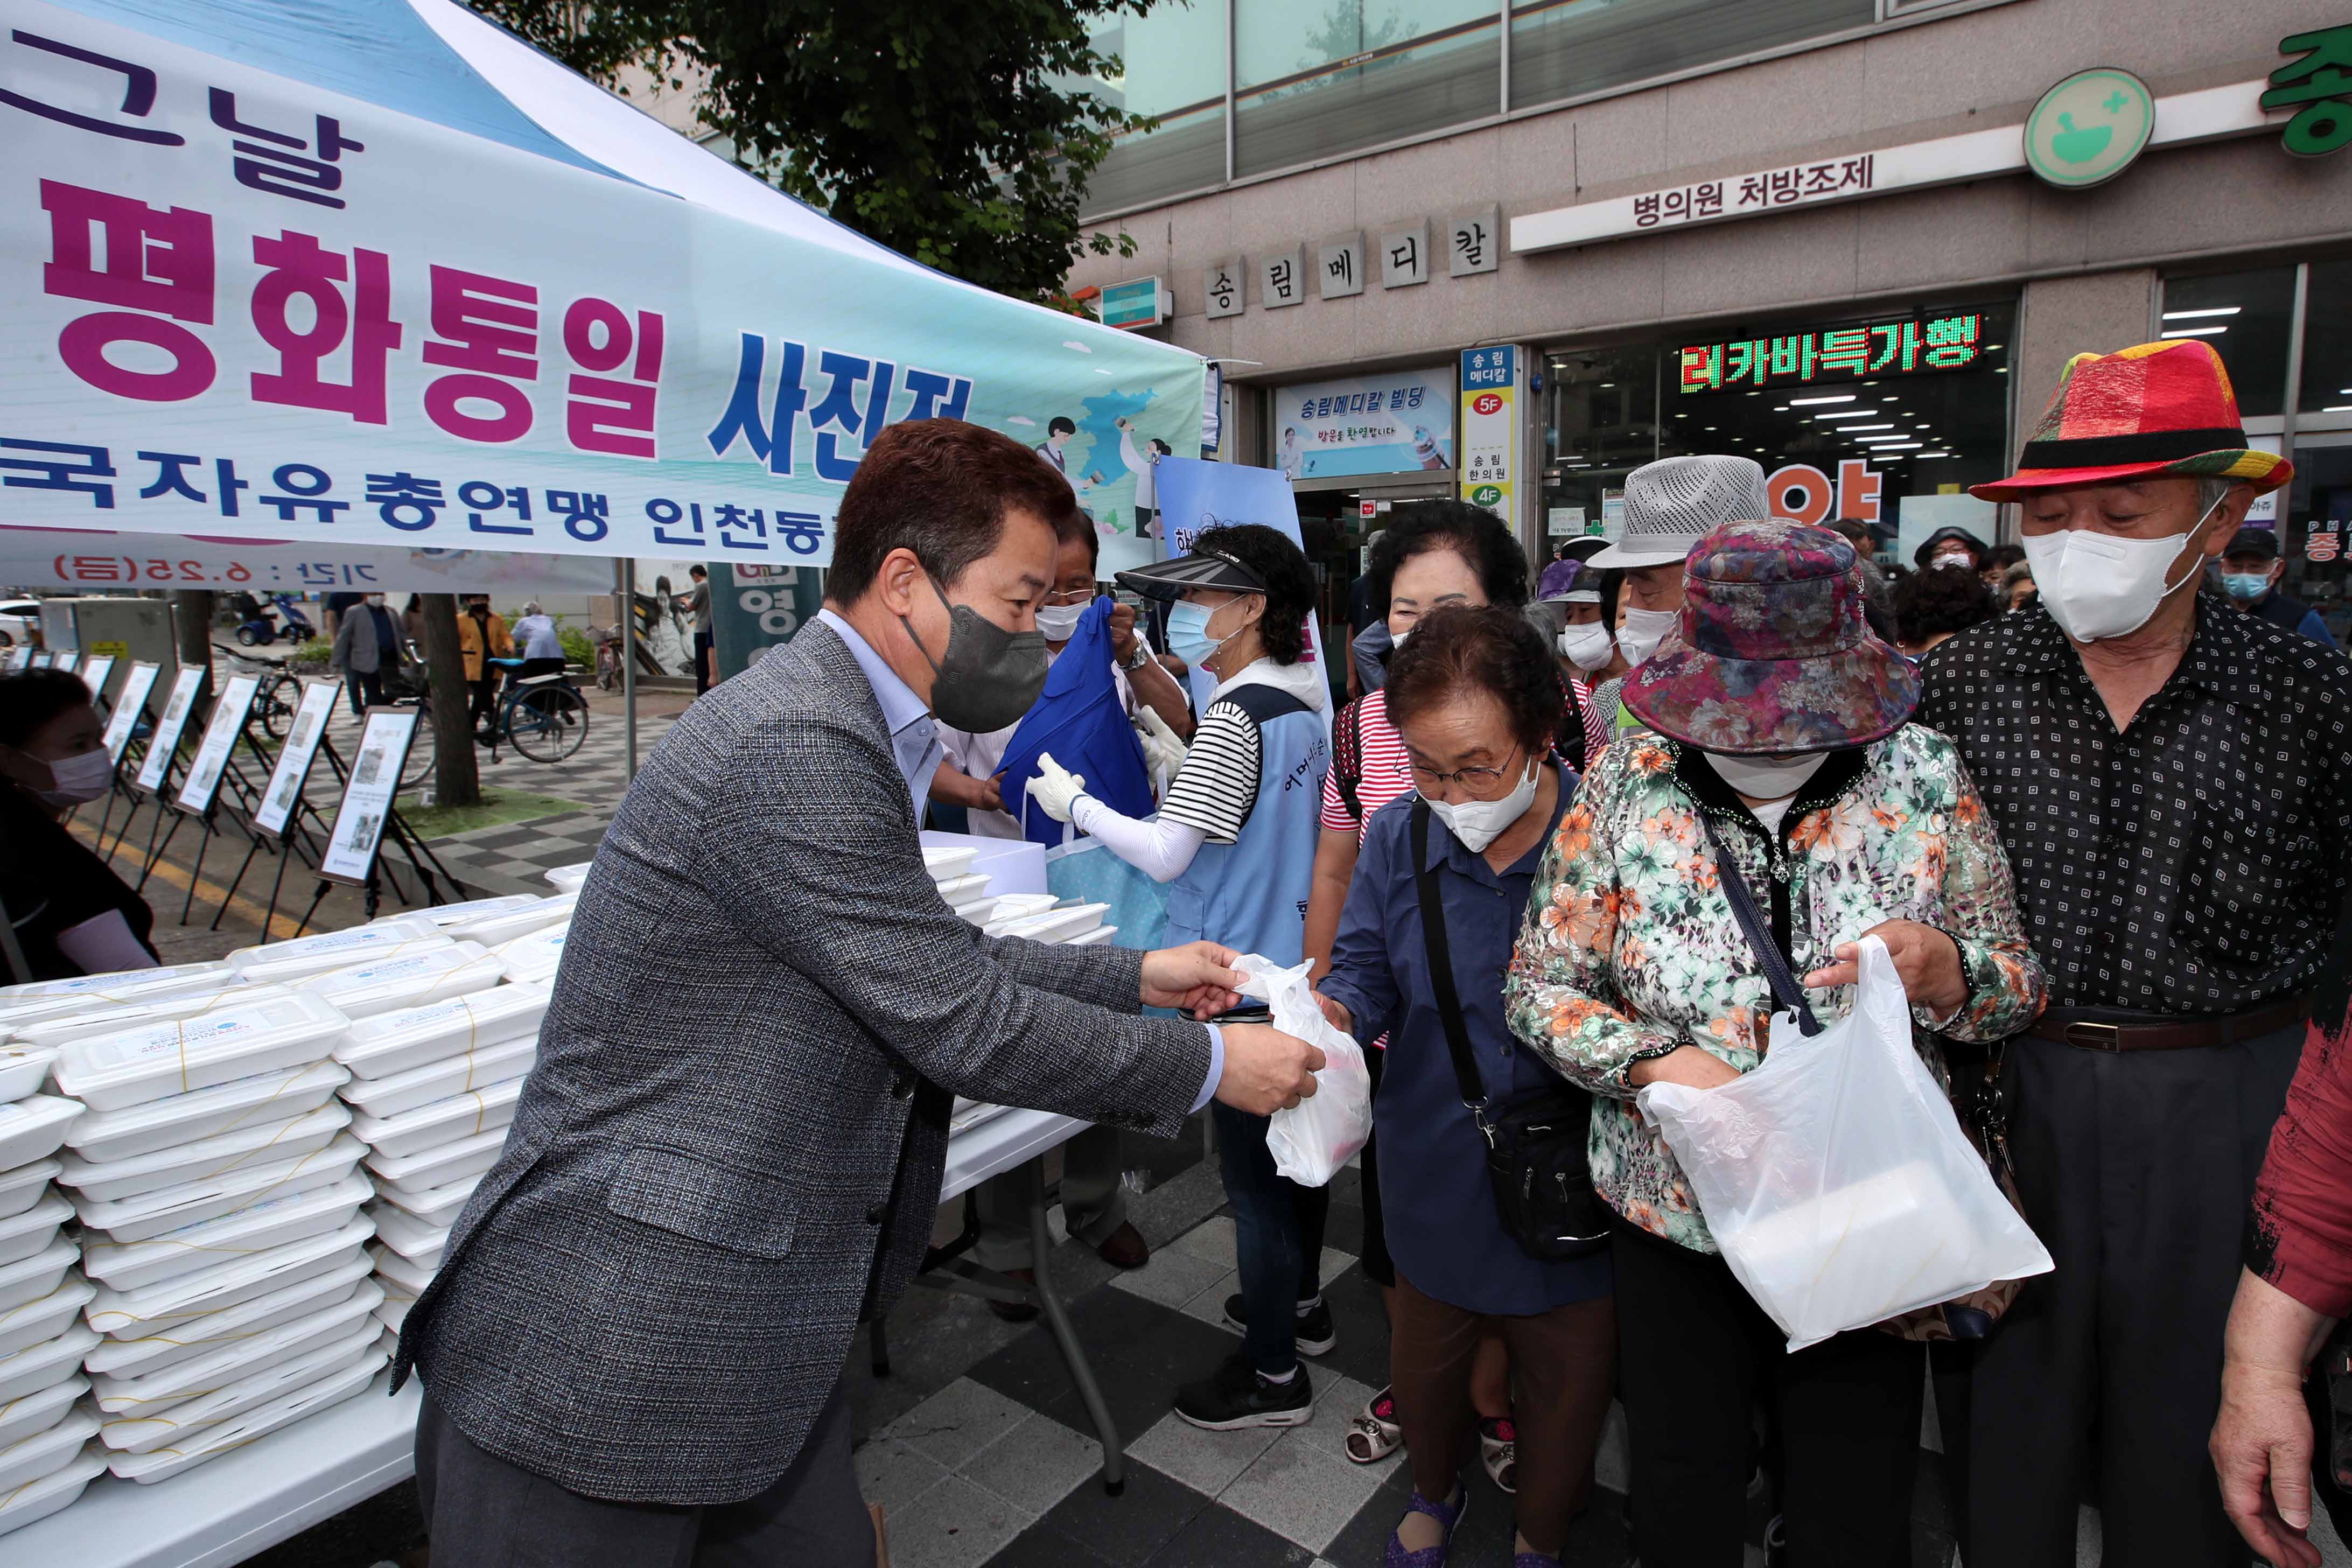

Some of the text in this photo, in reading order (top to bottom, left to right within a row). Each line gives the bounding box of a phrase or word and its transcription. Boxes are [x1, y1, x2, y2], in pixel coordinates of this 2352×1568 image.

[0, 29, 364, 209] 그날
[1633, 154, 1874, 227] 병의원 처방조제
[1209, 223, 1487, 309] 송림메디칼
[40, 178, 663, 458] 평화통일
[1470, 368, 1506, 383] 메디칼
[1301, 386, 1426, 420] 송림메디칼 빌딩
[1480, 398, 1498, 412] 5F
[1318, 426, 1396, 443] 방문을 환영합니다
[1469, 468, 1506, 481] 한의원
[1479, 488, 1497, 502] 4F
[646, 498, 837, 555] 인천동
